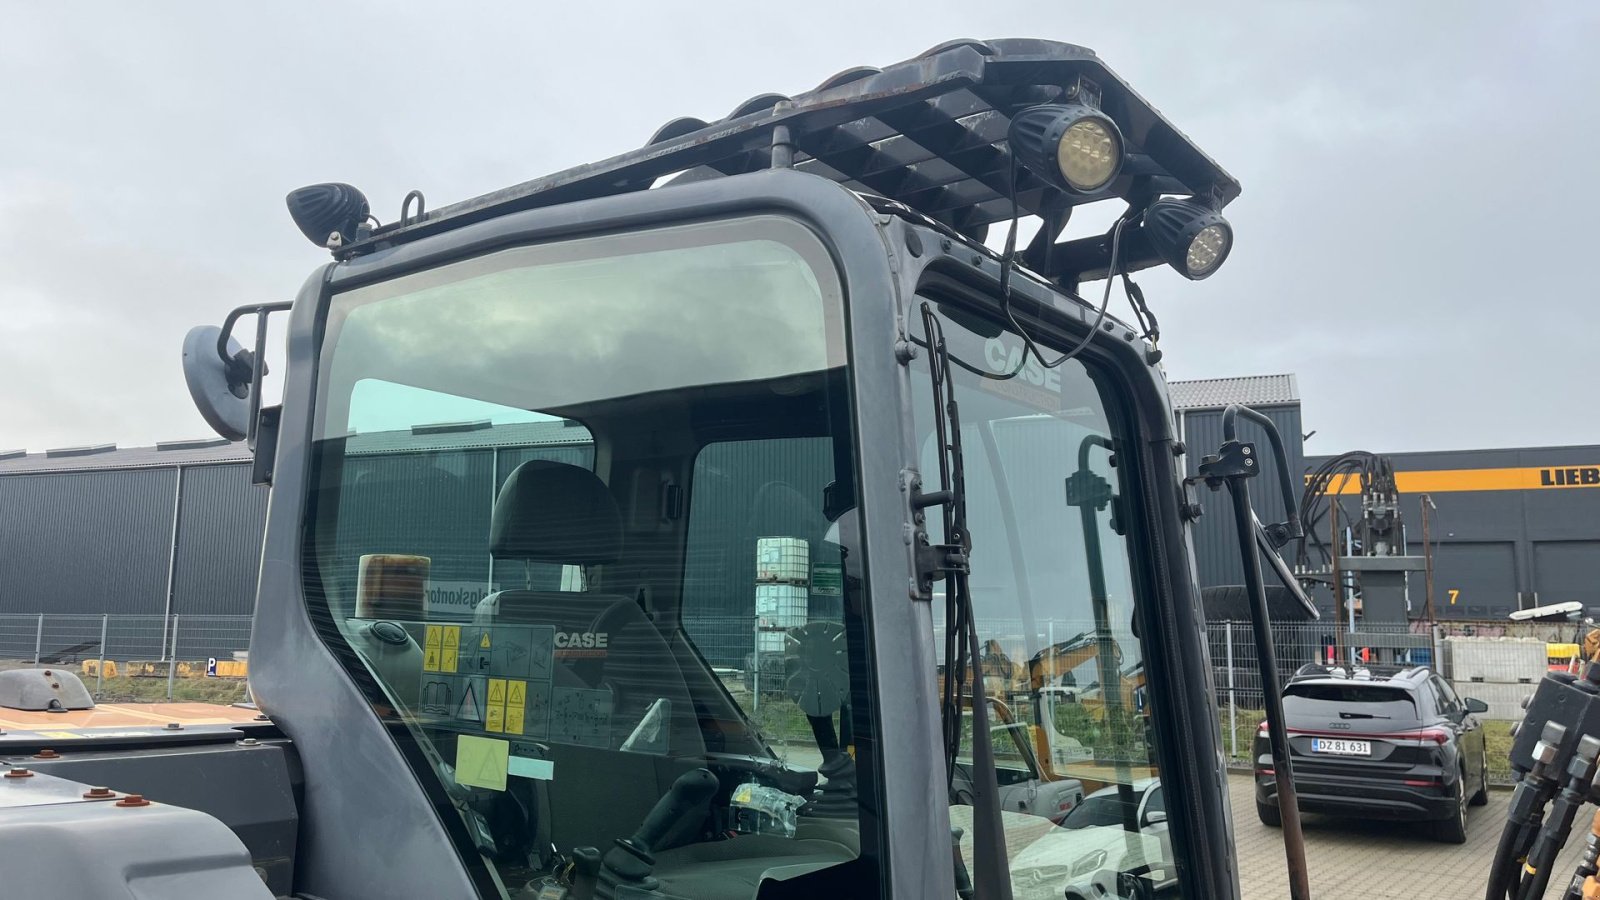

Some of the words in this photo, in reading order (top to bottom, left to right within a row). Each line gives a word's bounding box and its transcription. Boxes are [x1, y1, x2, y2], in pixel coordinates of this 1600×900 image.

[985, 338, 1061, 393] CASE
[1541, 468, 1600, 486] LIEB
[1448, 589, 1459, 605] 7
[554, 632, 608, 648] CASE
[208, 657, 216, 672] P
[1319, 740, 1333, 750] DZ
[1335, 740, 1346, 751] 81
[1350, 742, 1368, 753] 631
